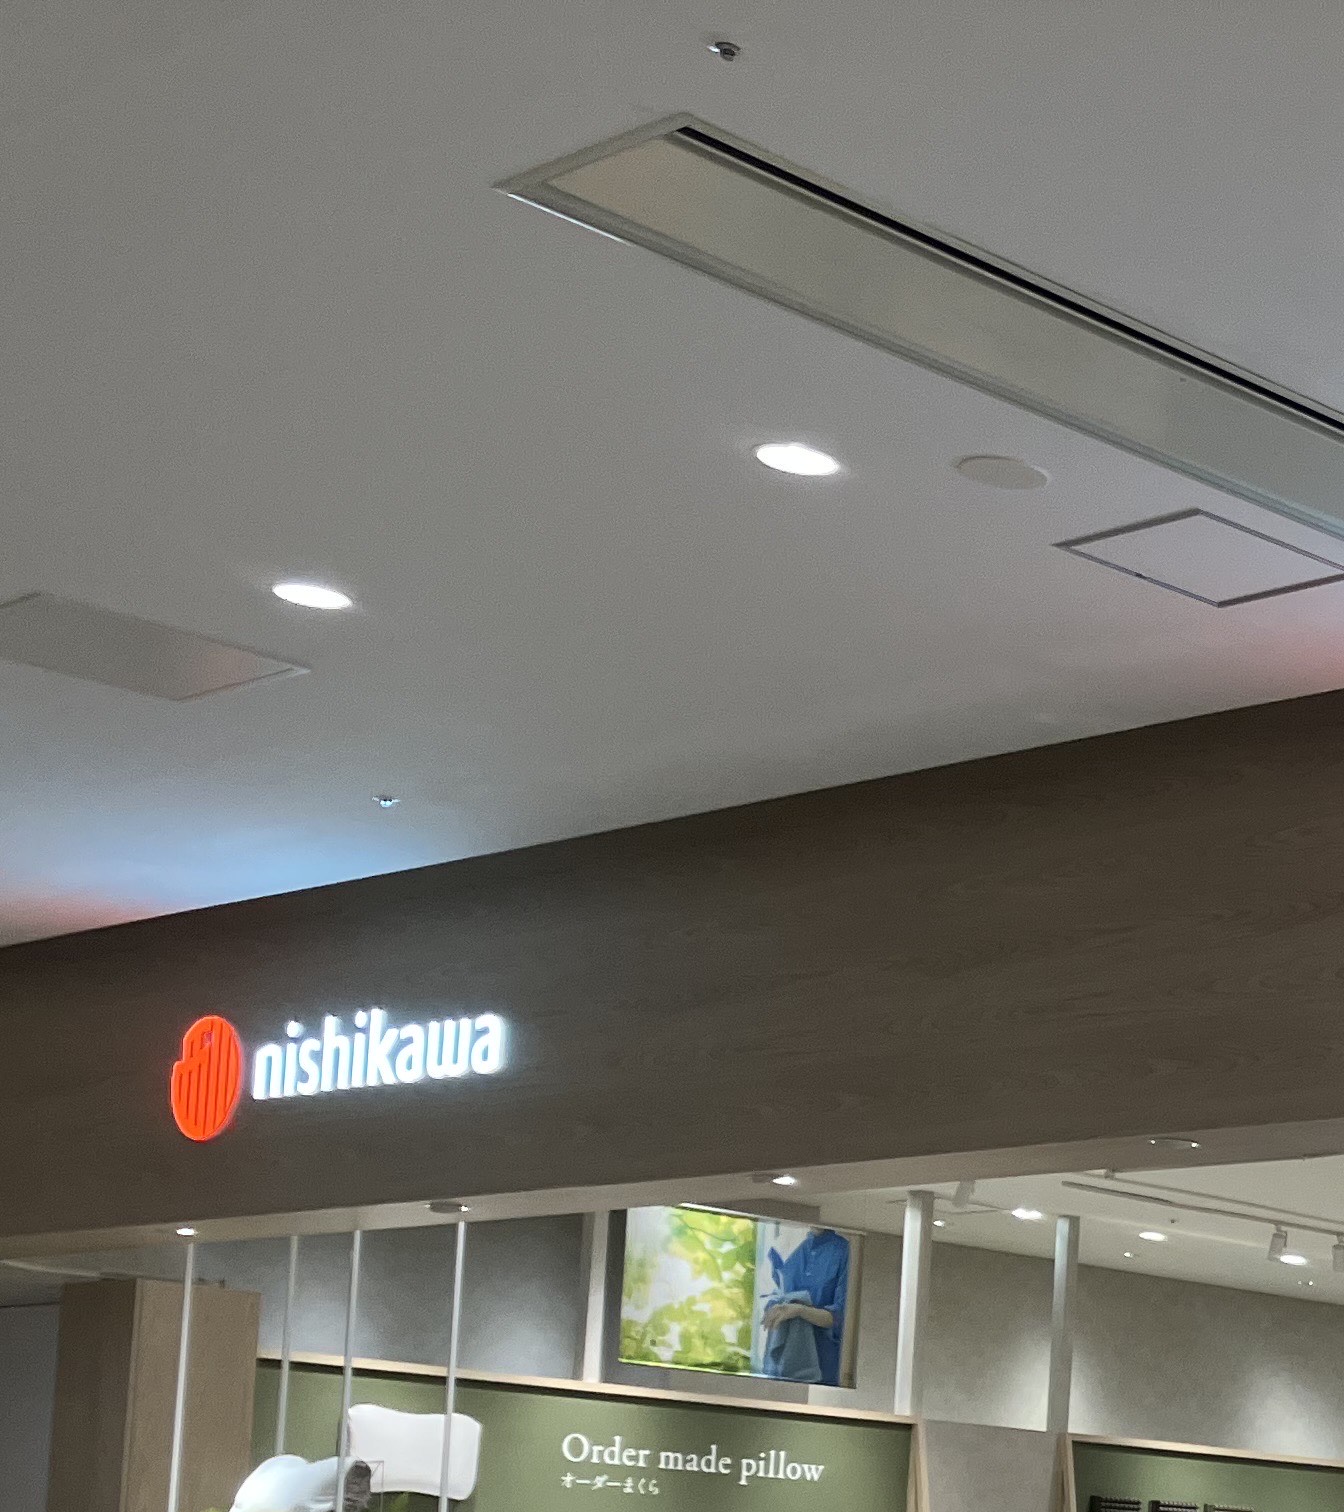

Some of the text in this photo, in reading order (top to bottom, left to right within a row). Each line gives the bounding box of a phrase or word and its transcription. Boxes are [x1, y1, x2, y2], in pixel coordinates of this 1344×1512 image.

[252, 1007, 508, 1101] nishikawa
[561, 1432, 825, 1486] Order made pillow
[561, 1471, 660, 1495] オーダーまくら
